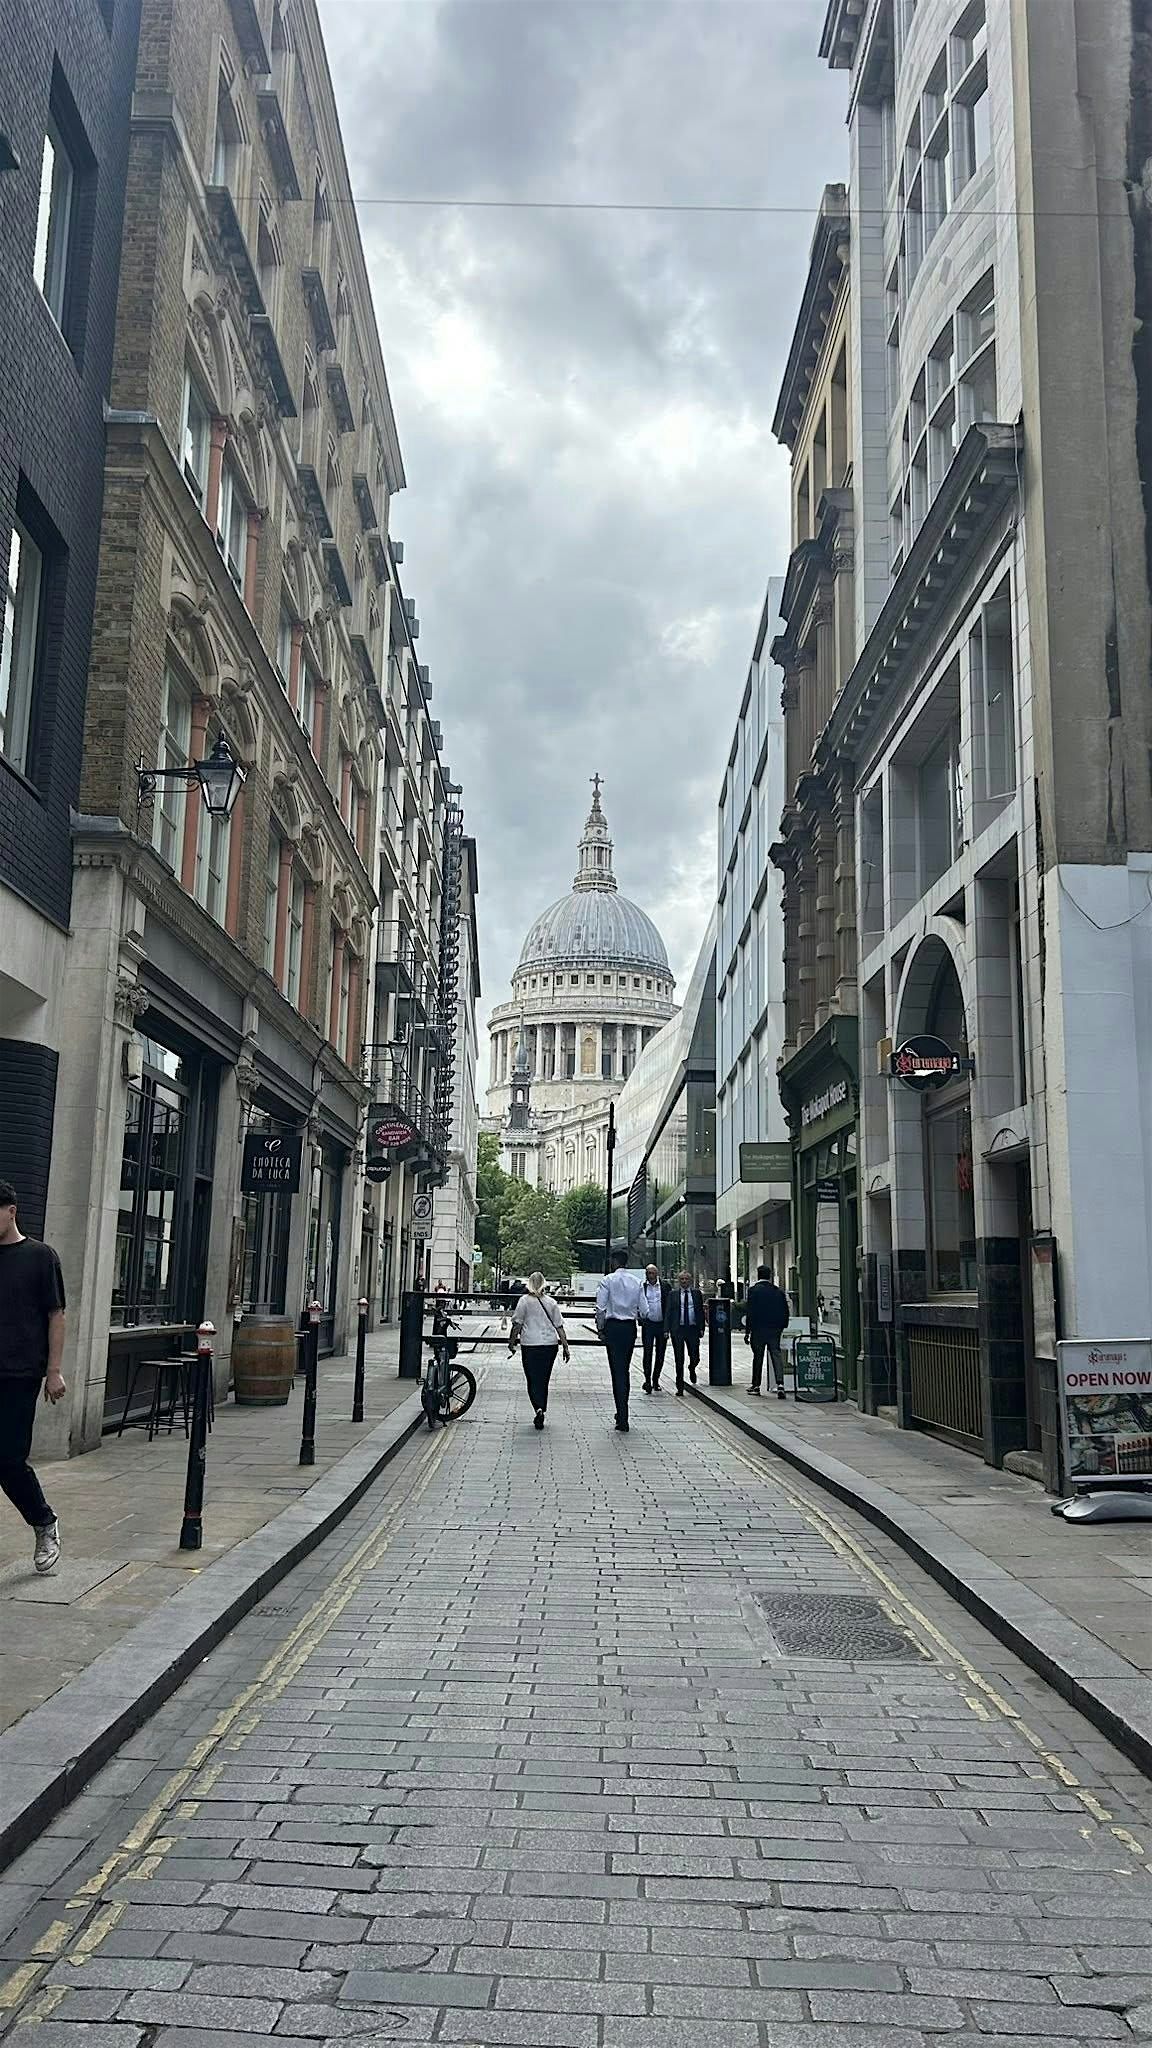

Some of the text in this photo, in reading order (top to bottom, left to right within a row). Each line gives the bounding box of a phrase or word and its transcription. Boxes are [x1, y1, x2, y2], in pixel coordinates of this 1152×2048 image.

[253, 1156, 290, 1168] ENOTECA
[252, 1168, 290, 1180] DA LUCA
[1066, 1371, 1151, 1387] OPEN NOW
